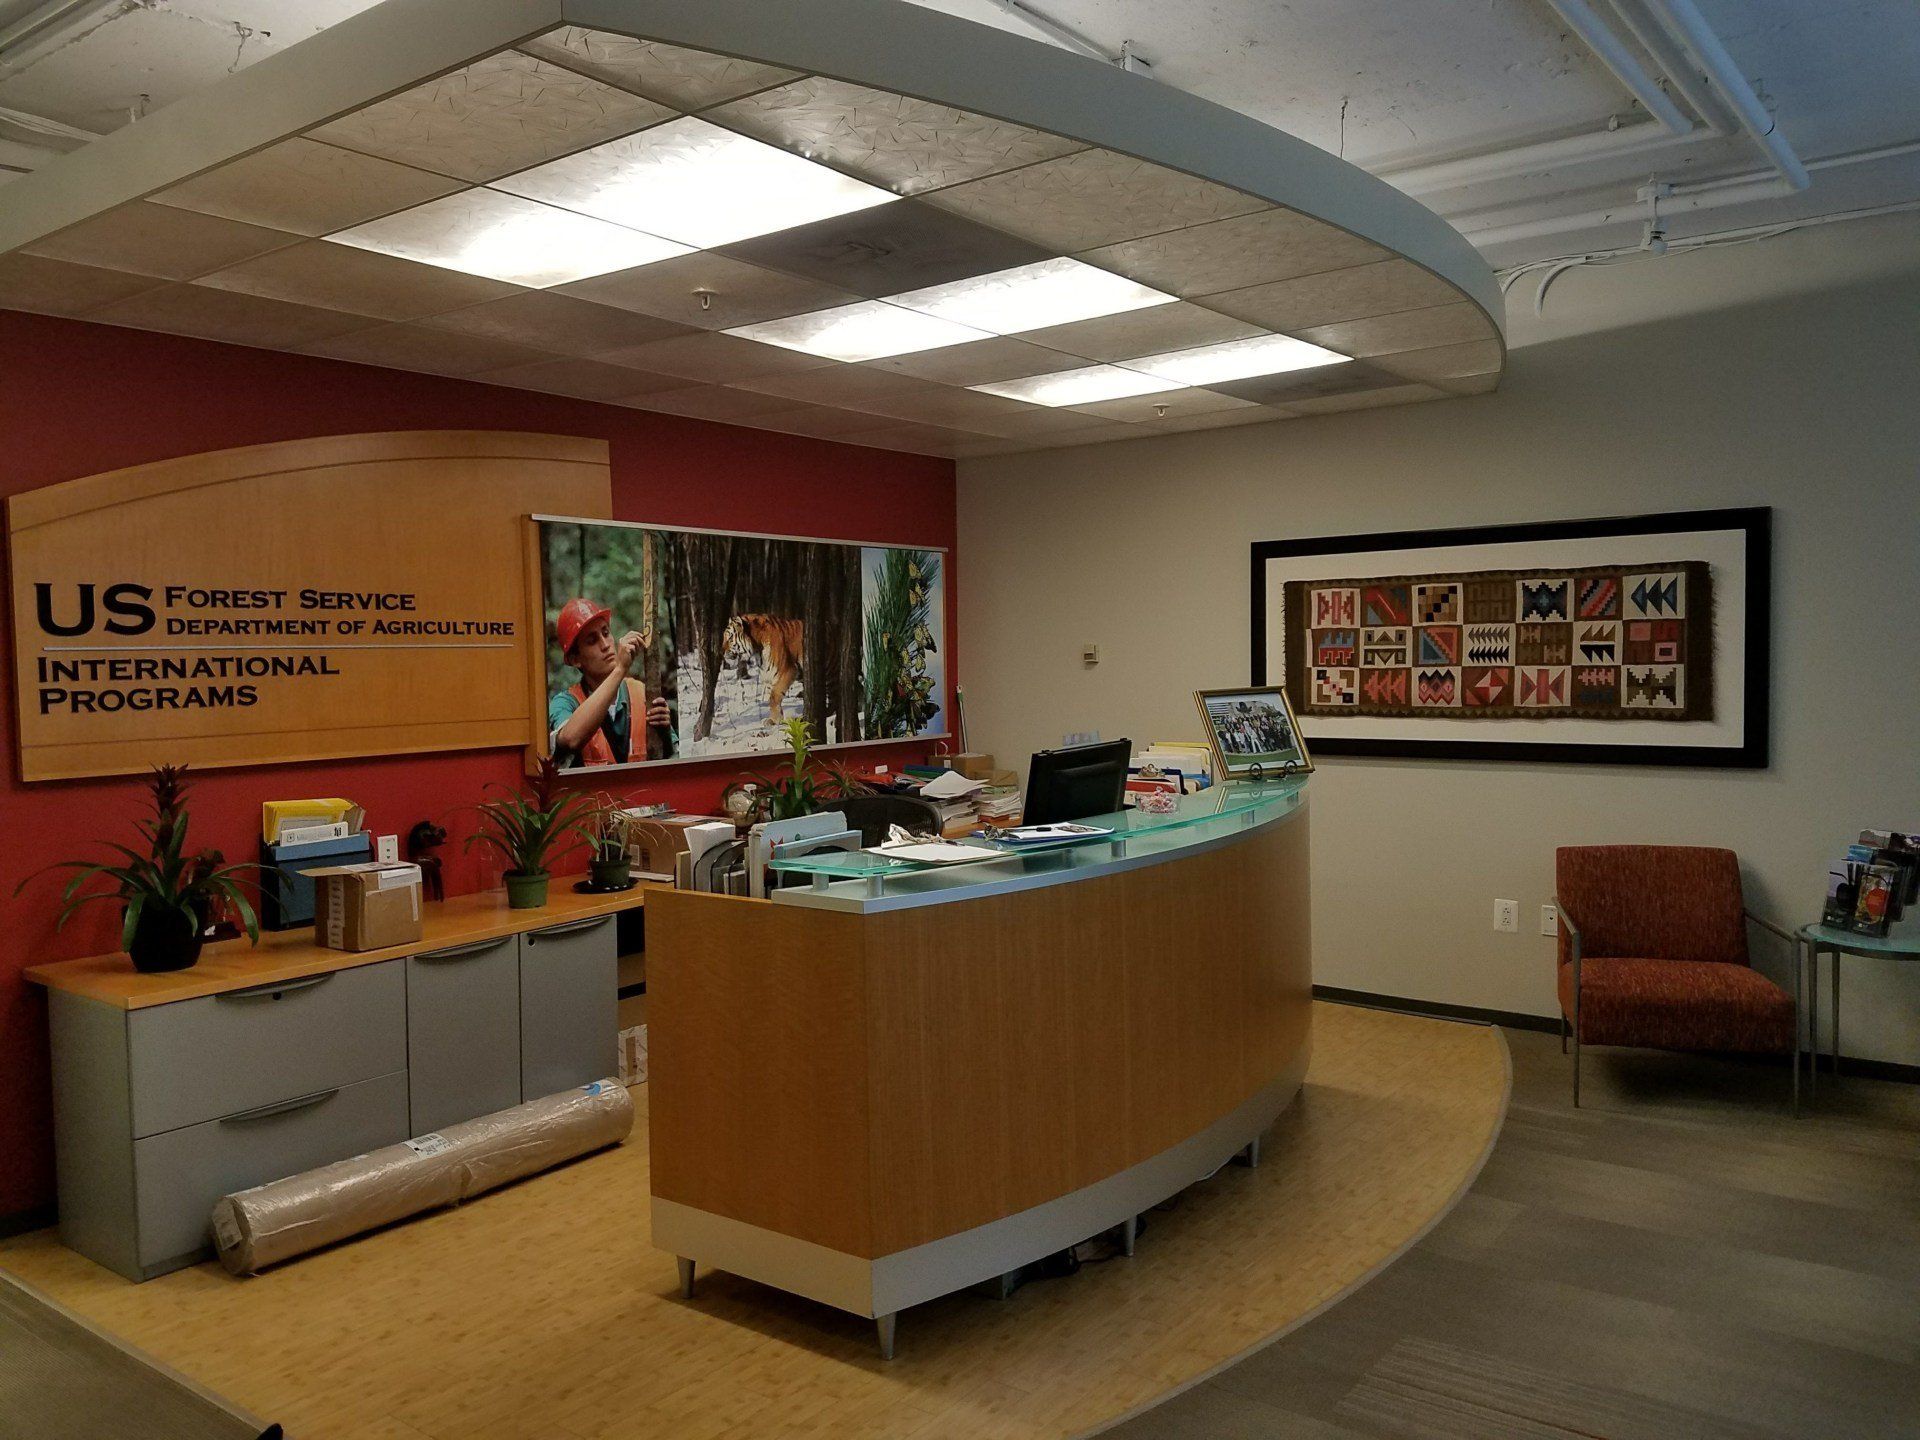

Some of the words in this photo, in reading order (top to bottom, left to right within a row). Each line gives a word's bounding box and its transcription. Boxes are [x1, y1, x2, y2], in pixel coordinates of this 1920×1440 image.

[35, 583, 156, 637] US
[165, 586, 287, 609] FOREST
[299, 589, 416, 611] SERVICE
[166, 617, 331, 636] DEPARTMENT
[336, 619, 366, 636] OF
[372, 618, 515, 636] AGRICULTURE
[37, 656, 340, 684] INTERNATIONAL
[38, 685, 258, 715] PROGRAMS
